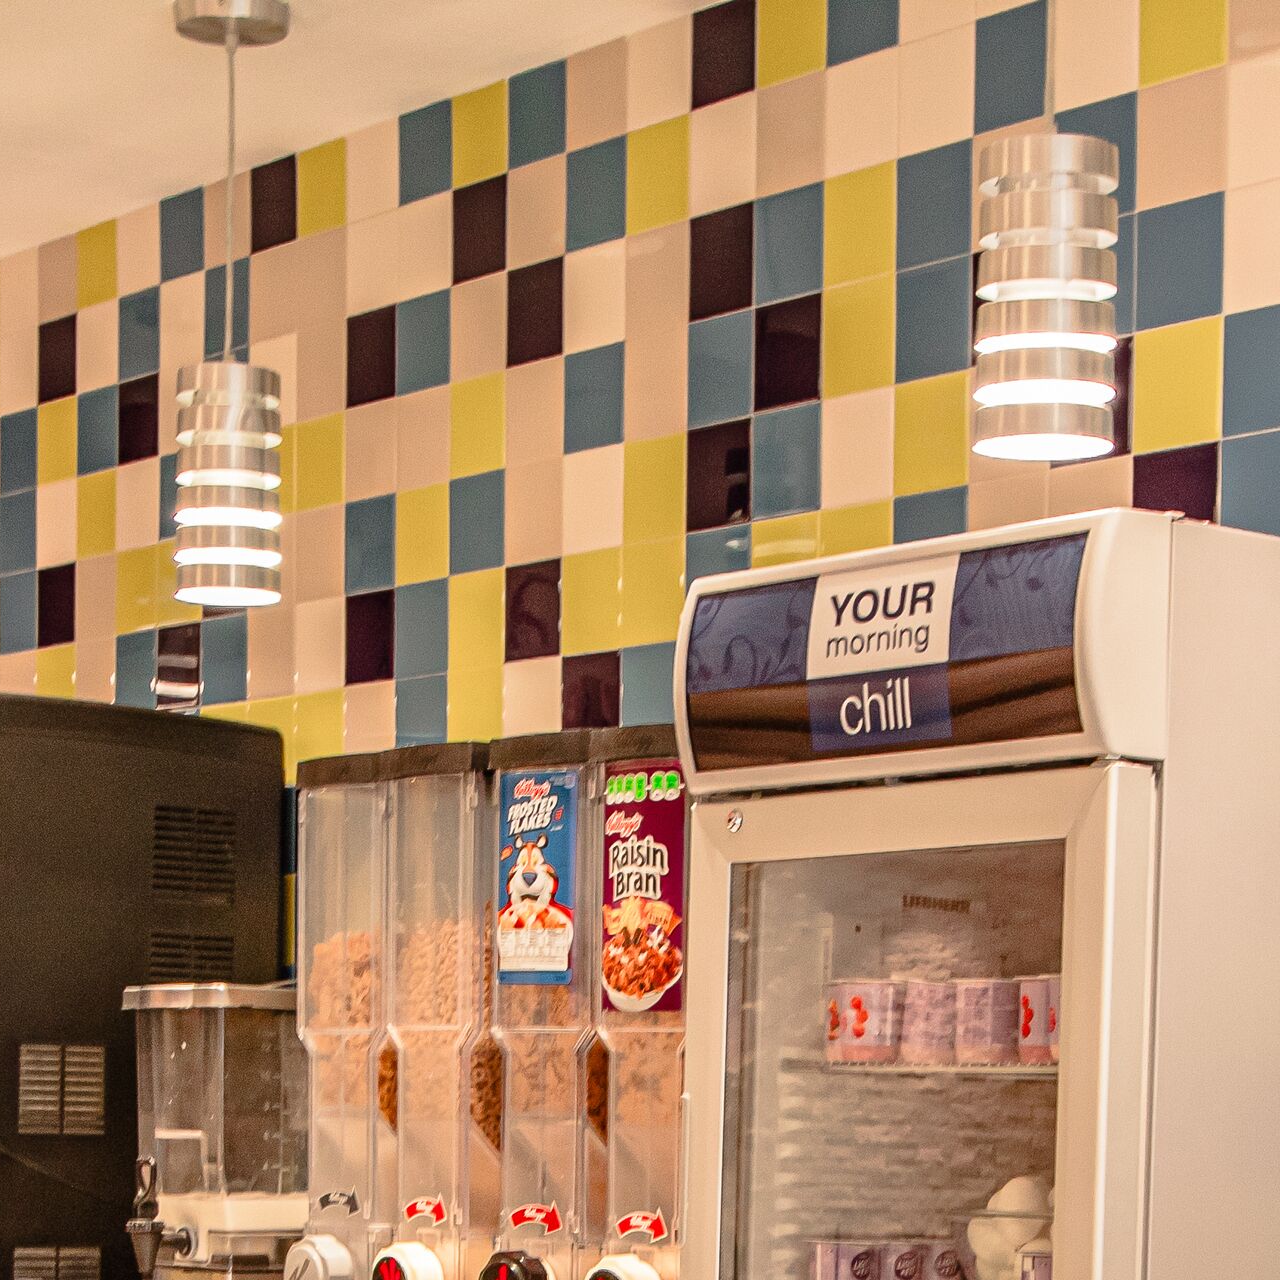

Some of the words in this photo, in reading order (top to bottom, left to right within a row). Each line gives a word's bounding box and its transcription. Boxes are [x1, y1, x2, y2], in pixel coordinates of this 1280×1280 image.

[830, 580, 936, 627] YOUR
[825, 623, 931, 660] morning
[839, 676, 913, 737] chill
[506, 794, 559, 823] FROSTED
[508, 811, 552, 837] FLAKES
[611, 838, 666, 873] Raisin
[615, 870, 657, 897] Bran
